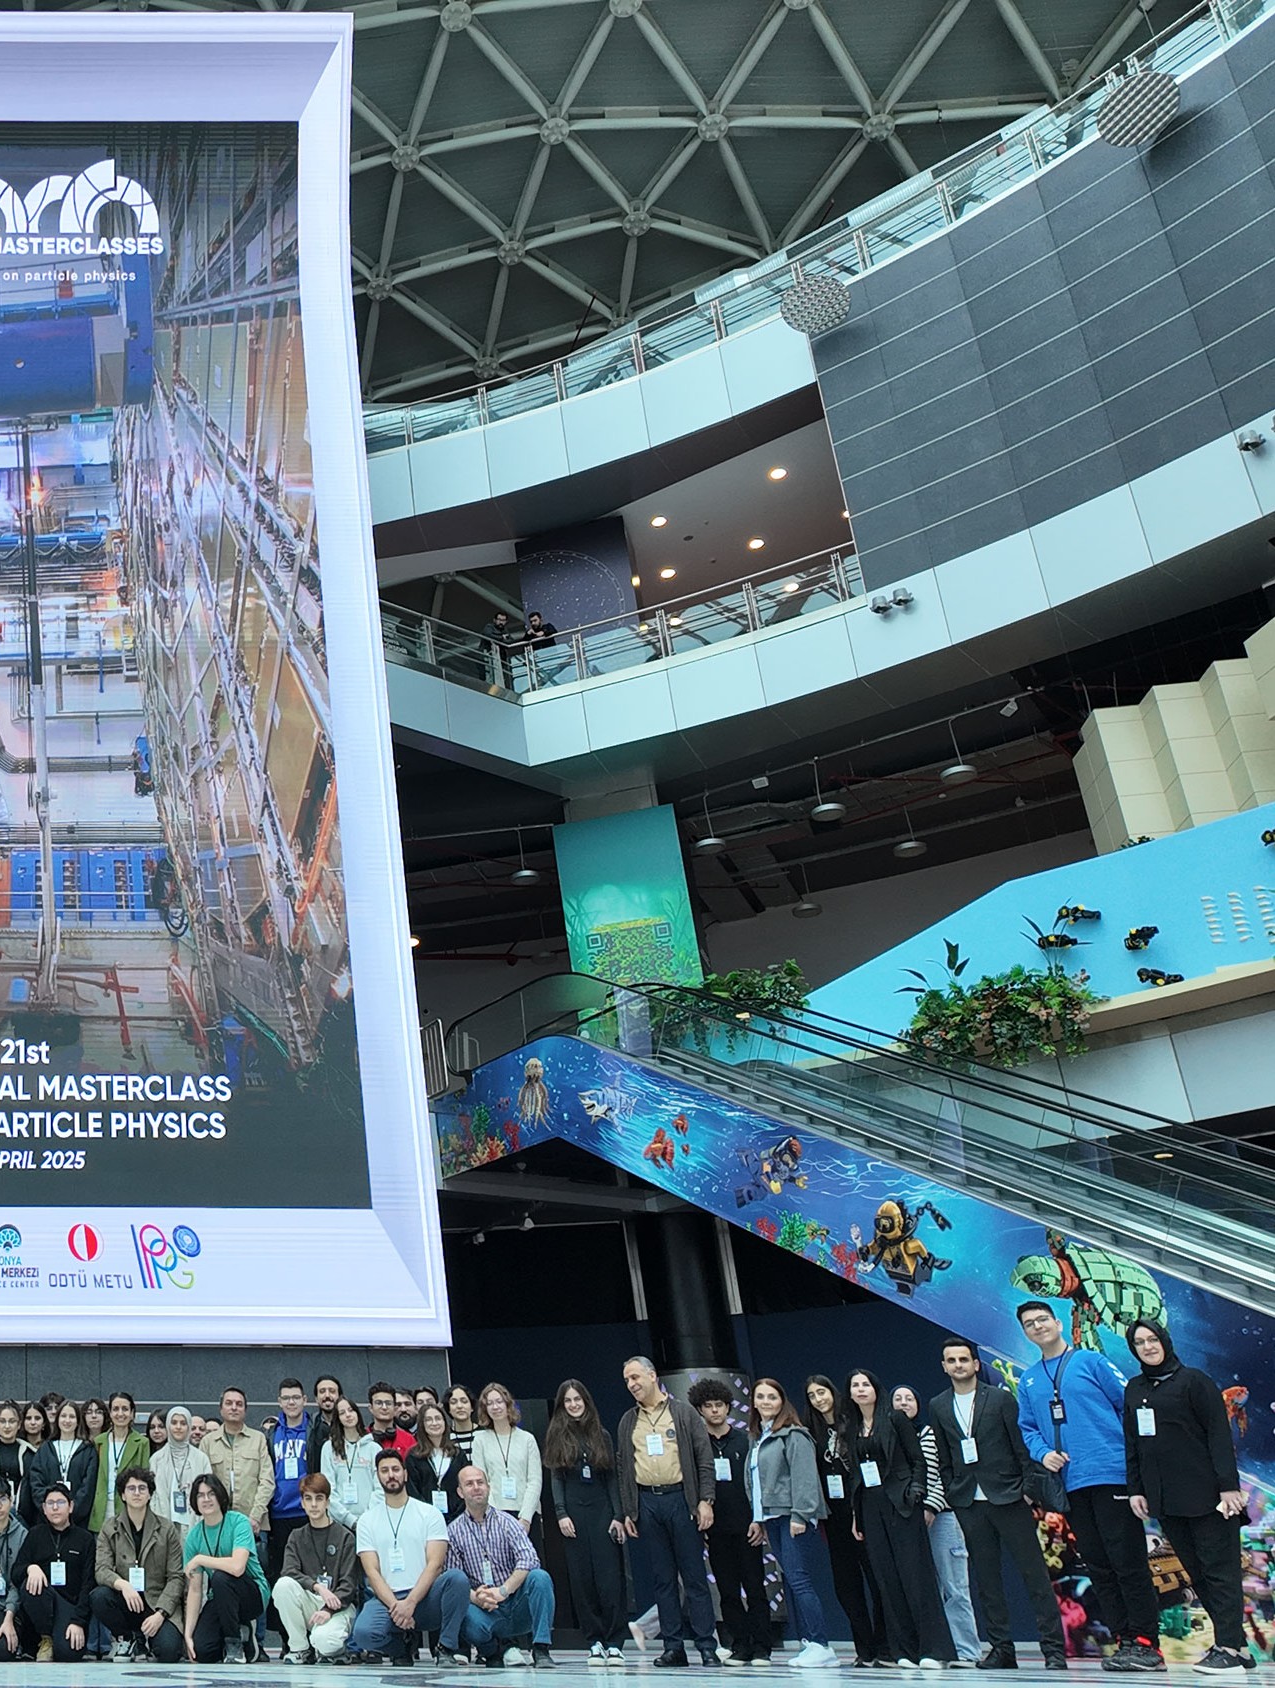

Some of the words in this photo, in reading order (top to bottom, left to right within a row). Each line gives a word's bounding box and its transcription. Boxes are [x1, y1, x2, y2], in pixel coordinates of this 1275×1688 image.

[2, 271, 19, 281] on
[24, 269, 78, 283] particle
[84, 269, 136, 283] physics
[0, 1038, 50, 1065] 21st
[38, 1074, 232, 1102] MASTERCLASS
[110, 1111, 226, 1139] PHYSICS
[40, 1150, 86, 1170] 2025
[10, 1280, 40, 1289] CENTER
[48, 1269, 87, 1289] ODTÜ
[93, 1273, 133, 1290] METU
